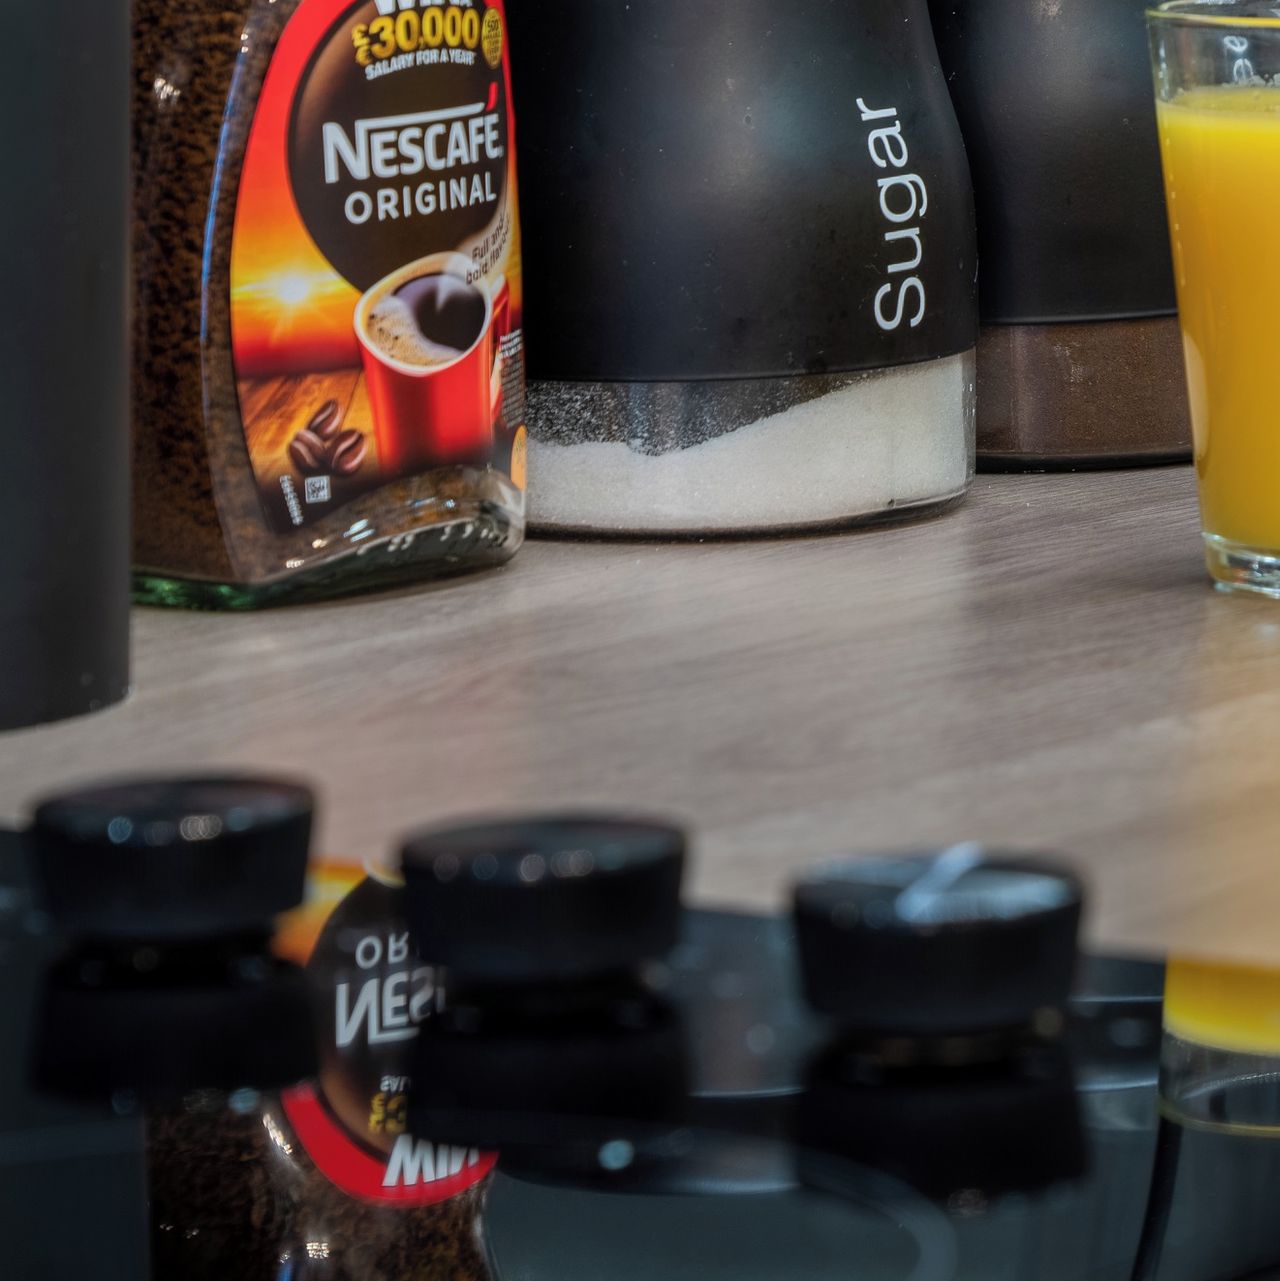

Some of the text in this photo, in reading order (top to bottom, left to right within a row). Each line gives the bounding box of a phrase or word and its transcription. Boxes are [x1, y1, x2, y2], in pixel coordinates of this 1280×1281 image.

[364, 48, 477, 81] SALARY FOR A YEAR
[344, 171, 497, 225] ORIGINAL
[856, 97, 928, 331] Sugar
